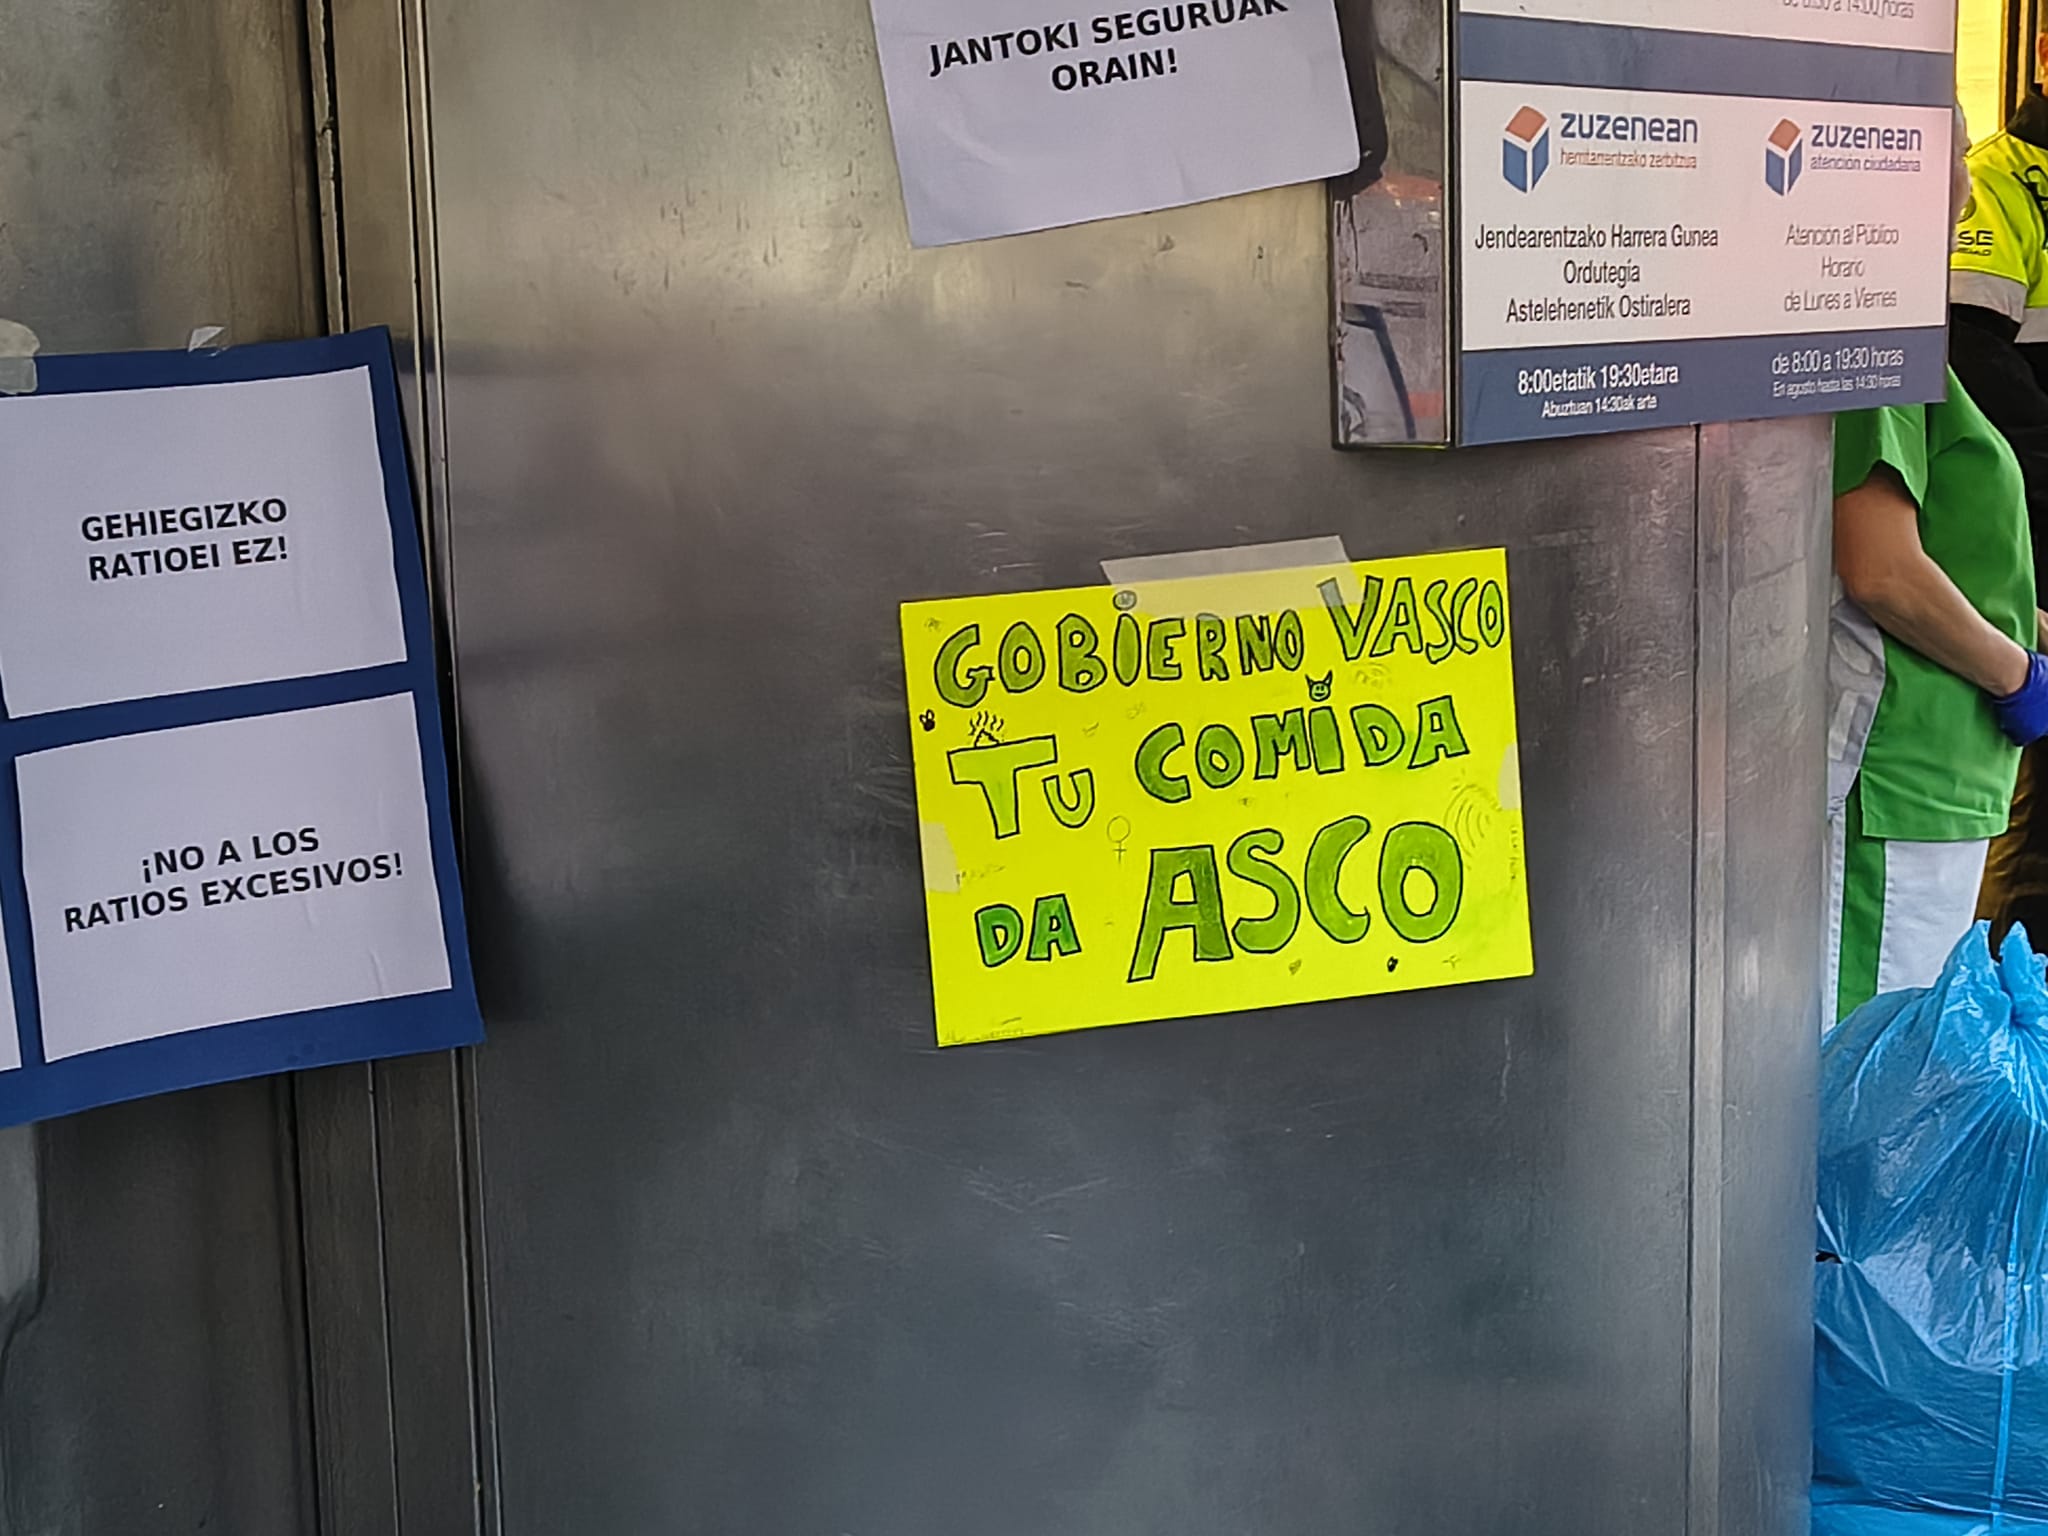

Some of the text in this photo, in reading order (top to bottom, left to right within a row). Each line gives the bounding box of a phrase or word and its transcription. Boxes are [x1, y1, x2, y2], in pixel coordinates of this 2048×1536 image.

[930, 0, 1288, 77] JANTOKI SEGURUAK
[1051, 48, 1178, 91] ORAIN!
[1560, 112, 1698, 143] zuzenean
[1811, 124, 1922, 151] zuzenean
[1863, 155, 1921, 172] ciudadana
[1475, 224, 1719, 248] Jendearentzako Harrera Gunea
[1785, 223, 1840, 246] Atención
[1843, 224, 1854, 245] al
[1563, 259, 1640, 288] Ordutegia
[1821, 255, 1866, 278] Horario
[1506, 294, 1691, 323] Astelehenetik Ostiralera
[1784, 286, 1897, 312] de Lunes a Viernes
[1772, 346, 1904, 375] de 8:00 a 19:30 horas
[1517, 362, 1679, 395] 8:00etatik 19:30etara
[81, 498, 288, 541] GEHIEGIZKO
[88, 536, 289, 581] RATIOEI EZ!
[1317, 576, 1505, 664] VASCO
[140, 827, 320, 884] ¡NO A LOS
[64, 853, 404, 934] RATIOS EXCESIVOS!
[975, 894, 1082, 968] DA
[1127, 815, 1464, 983] ASCO
